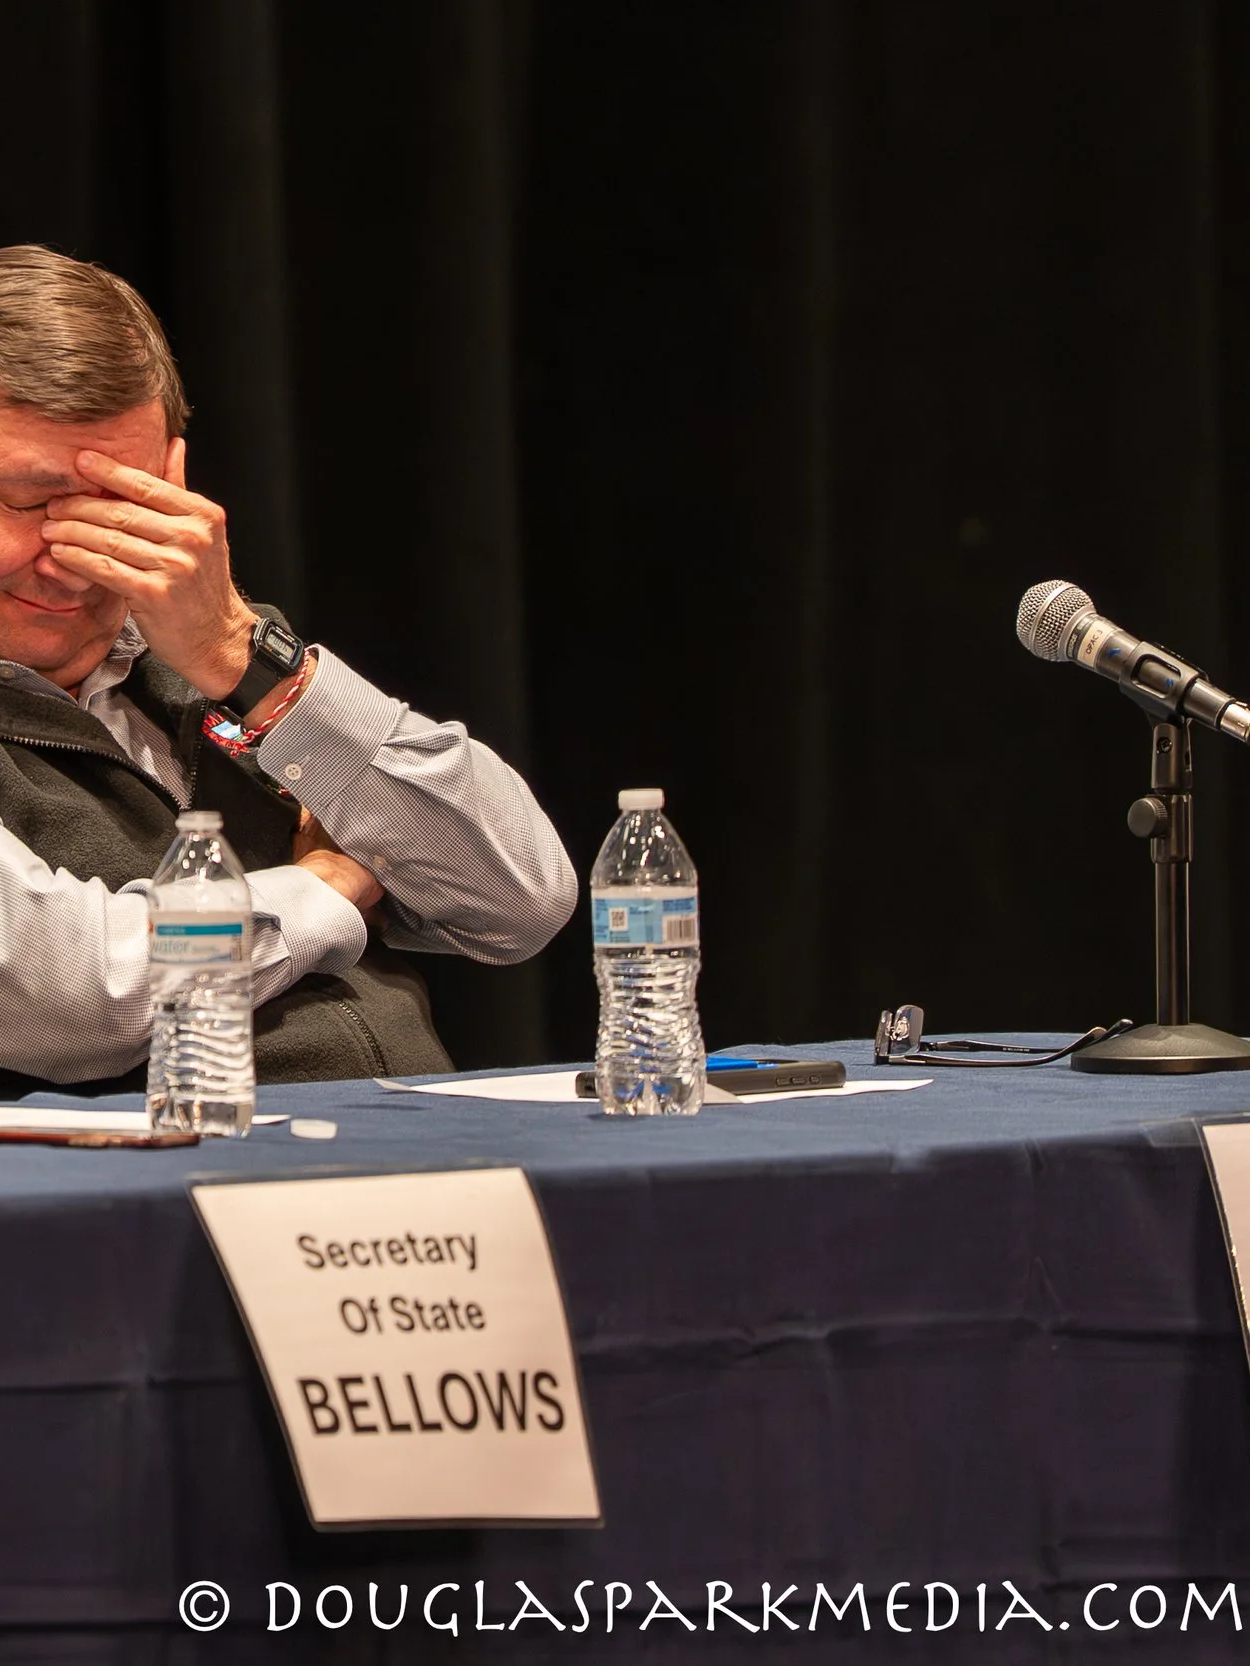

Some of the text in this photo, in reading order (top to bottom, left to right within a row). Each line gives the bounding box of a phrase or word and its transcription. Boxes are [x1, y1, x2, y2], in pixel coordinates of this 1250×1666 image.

[297, 1232, 477, 1271] Secretary
[340, 1297, 486, 1334] Of State
[297, 1370, 565, 1436] BELLOWS
